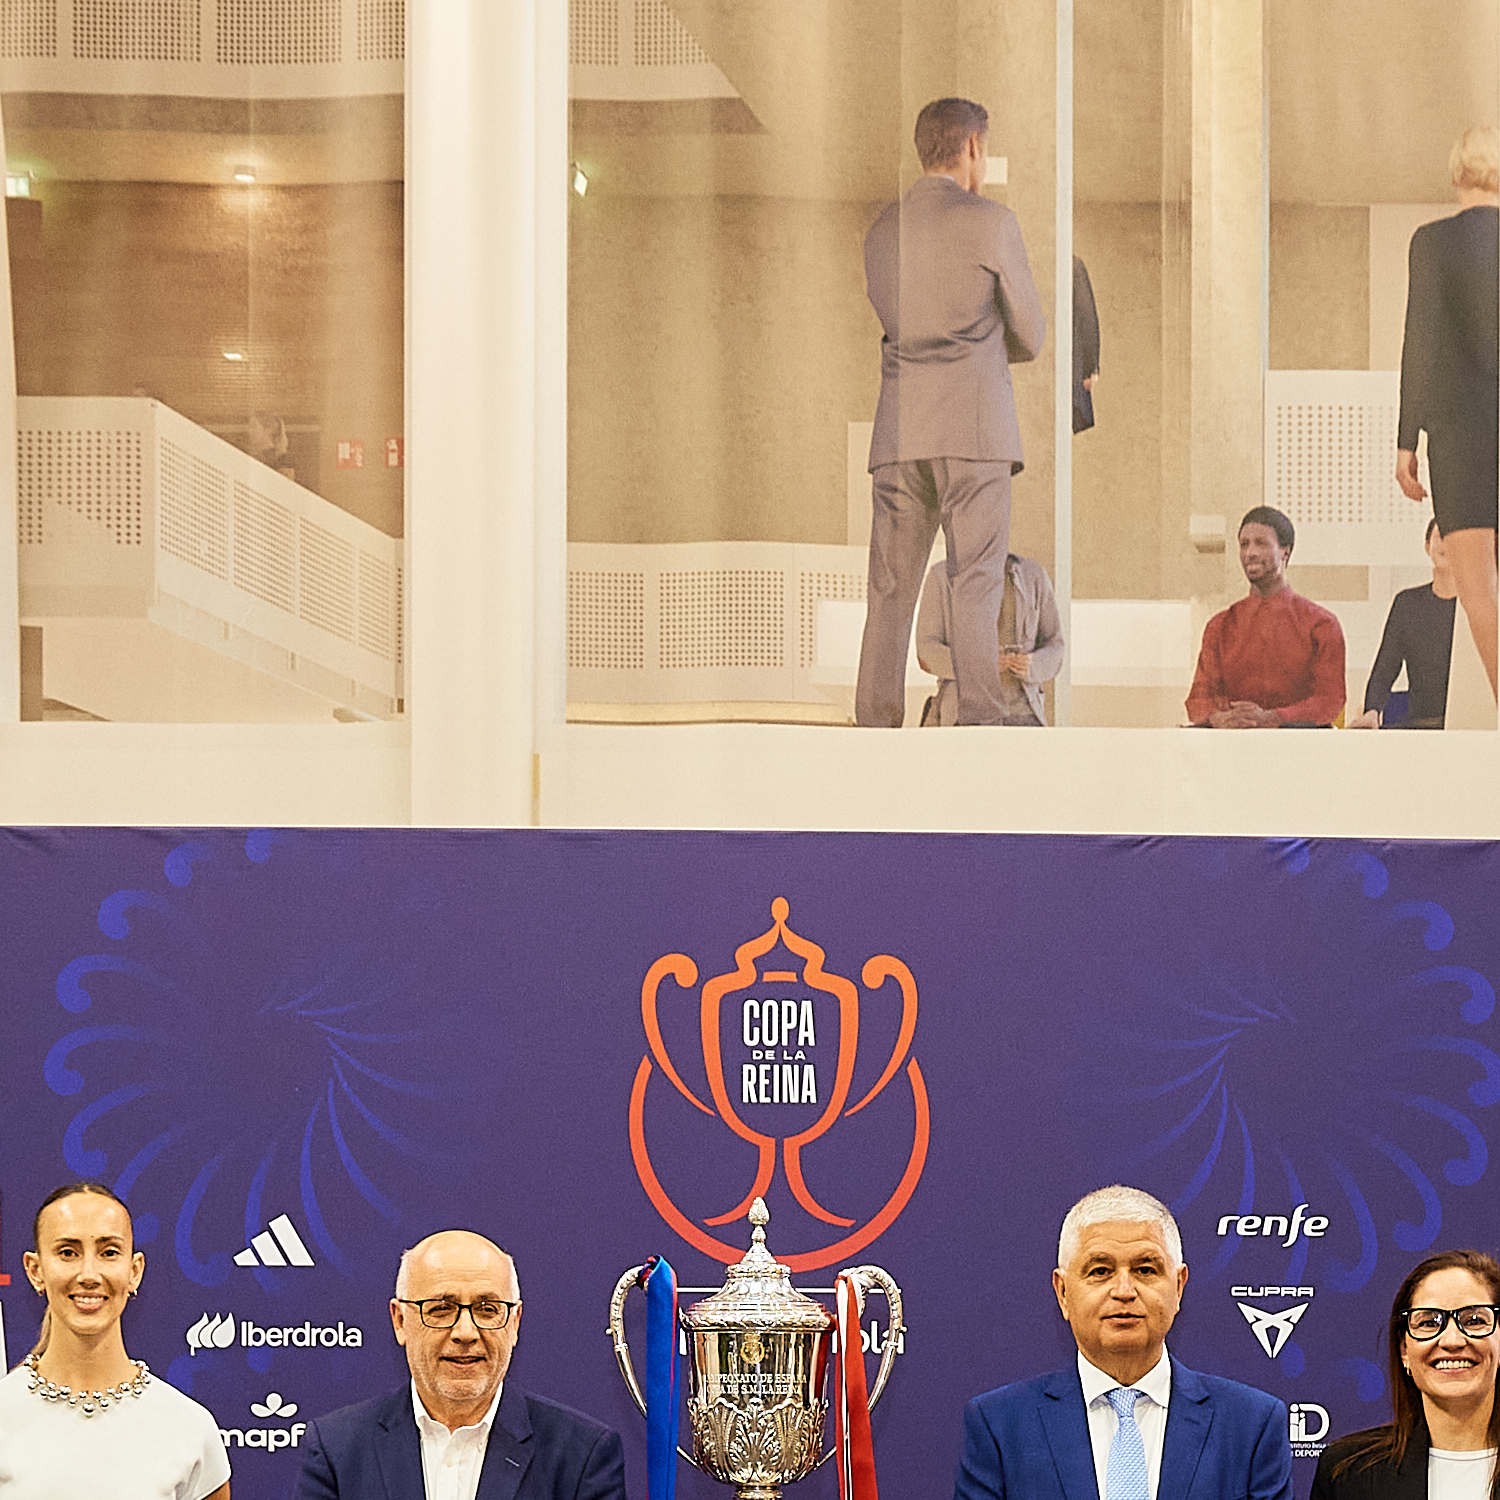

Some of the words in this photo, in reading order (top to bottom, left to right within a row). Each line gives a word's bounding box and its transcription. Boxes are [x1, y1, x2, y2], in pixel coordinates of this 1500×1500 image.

[743, 999, 816, 1047] COPA
[752, 1049, 776, 1060] DE
[783, 1049, 806, 1060] LA
[742, 1064, 817, 1104] REINA
[1217, 1203, 1330, 1248] renfe
[1231, 1286, 1314, 1297] CUPRA
[240, 1321, 363, 1348] Iberdrola
[218, 1422, 307, 1453] mapf
